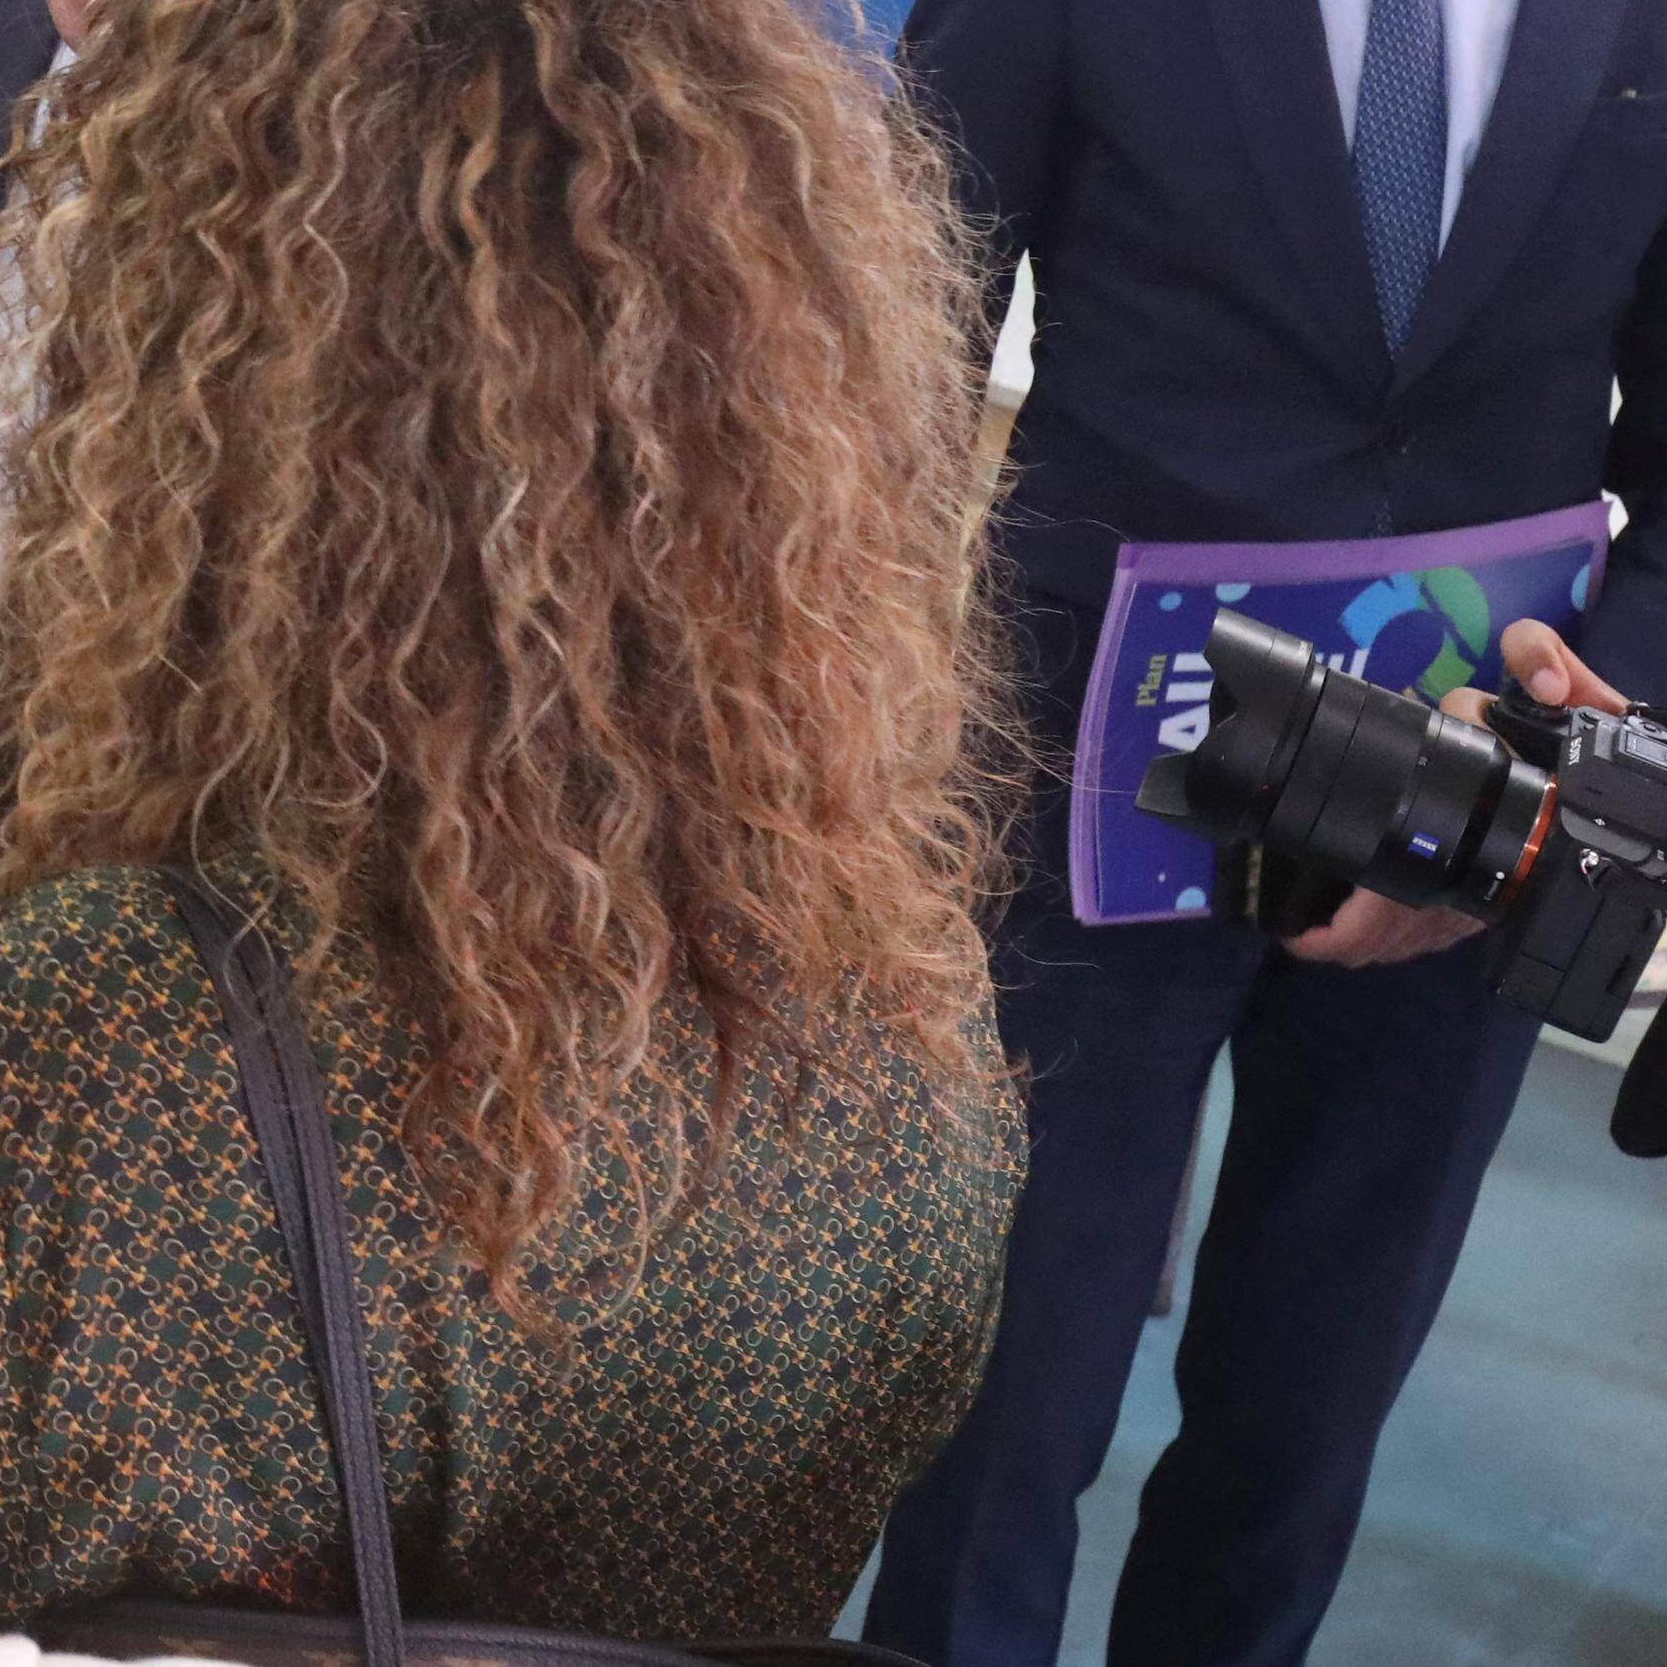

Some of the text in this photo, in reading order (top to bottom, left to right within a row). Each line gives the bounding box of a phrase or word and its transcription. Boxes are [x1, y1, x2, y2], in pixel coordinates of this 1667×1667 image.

[1135, 654, 1167, 707] Plan
[1569, 736, 1583, 766] SONY
[1411, 836, 1438, 852] ZEISS
